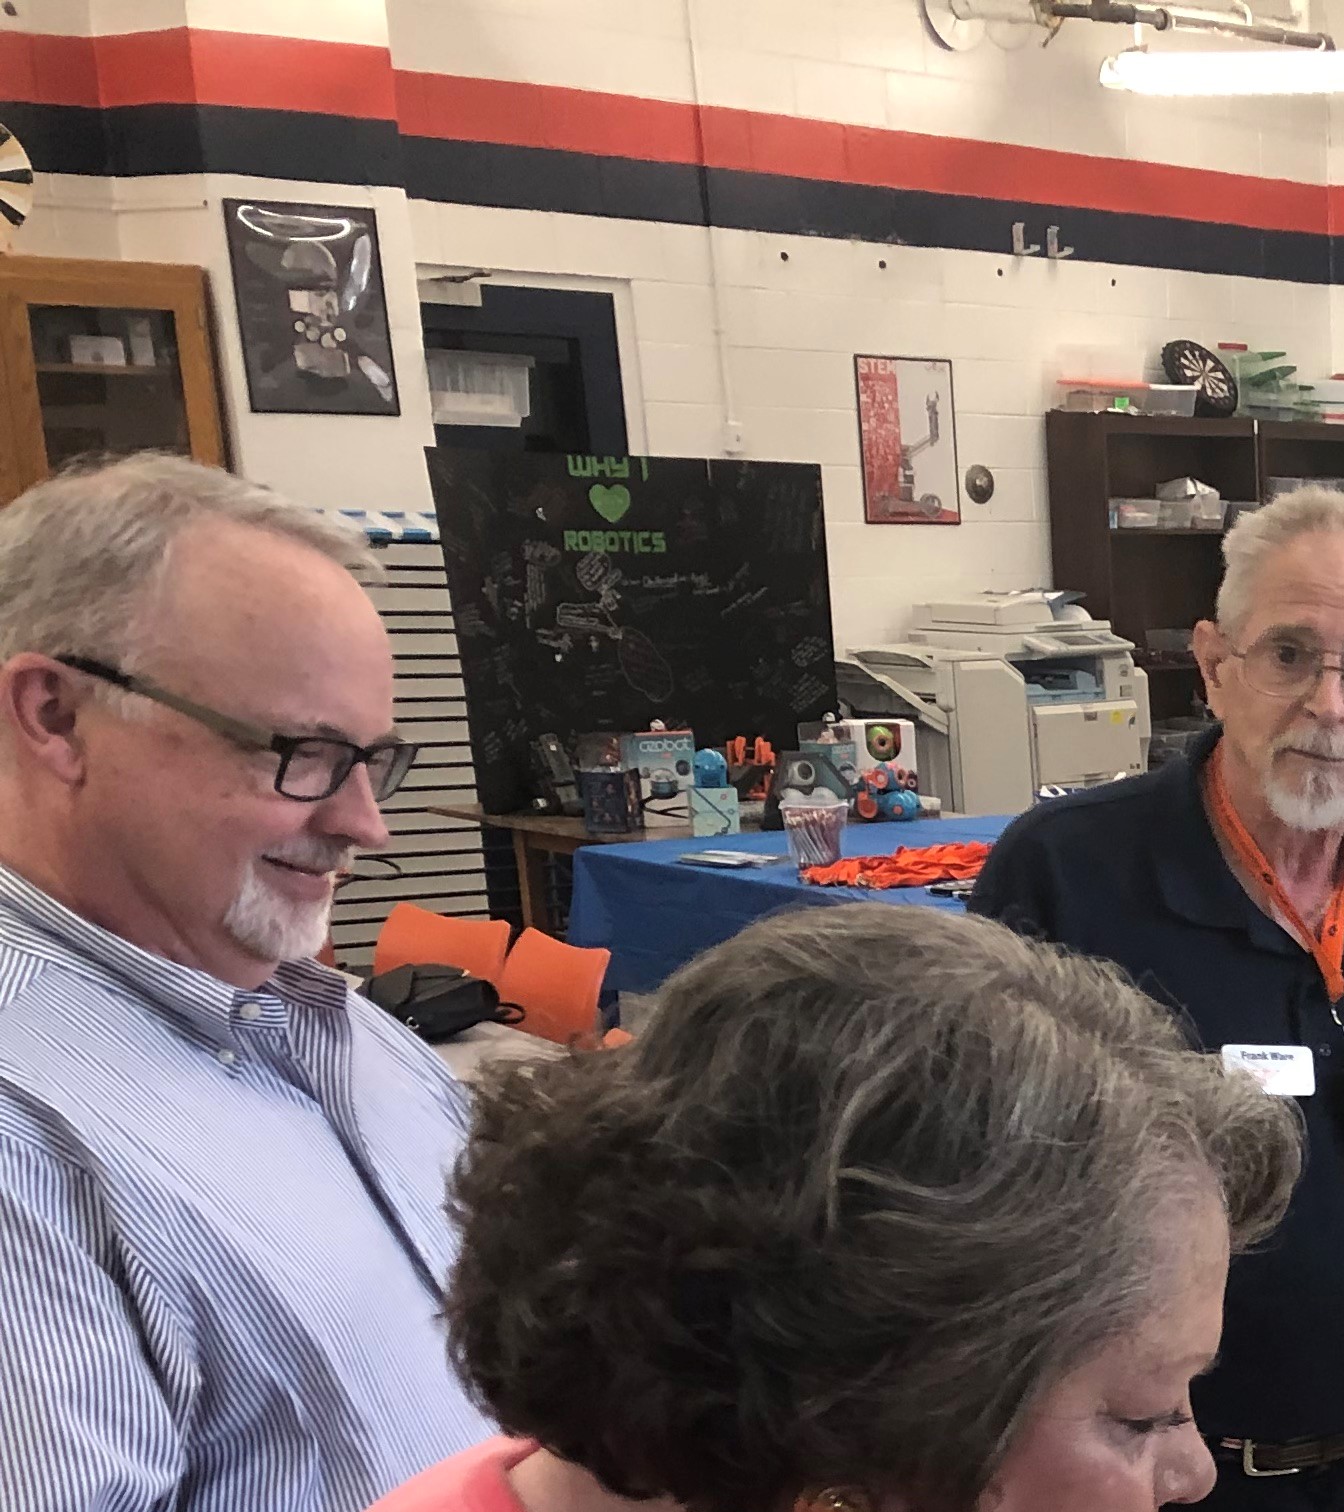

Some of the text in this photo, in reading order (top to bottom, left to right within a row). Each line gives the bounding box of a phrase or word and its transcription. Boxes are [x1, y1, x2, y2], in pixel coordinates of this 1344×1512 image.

[566, 454, 630, 478] WHY
[563, 530, 668, 553] ROBOTICS
[638, 736, 693, 752] ozobot
[1240, 1050, 1295, 1061] Frank Ware
